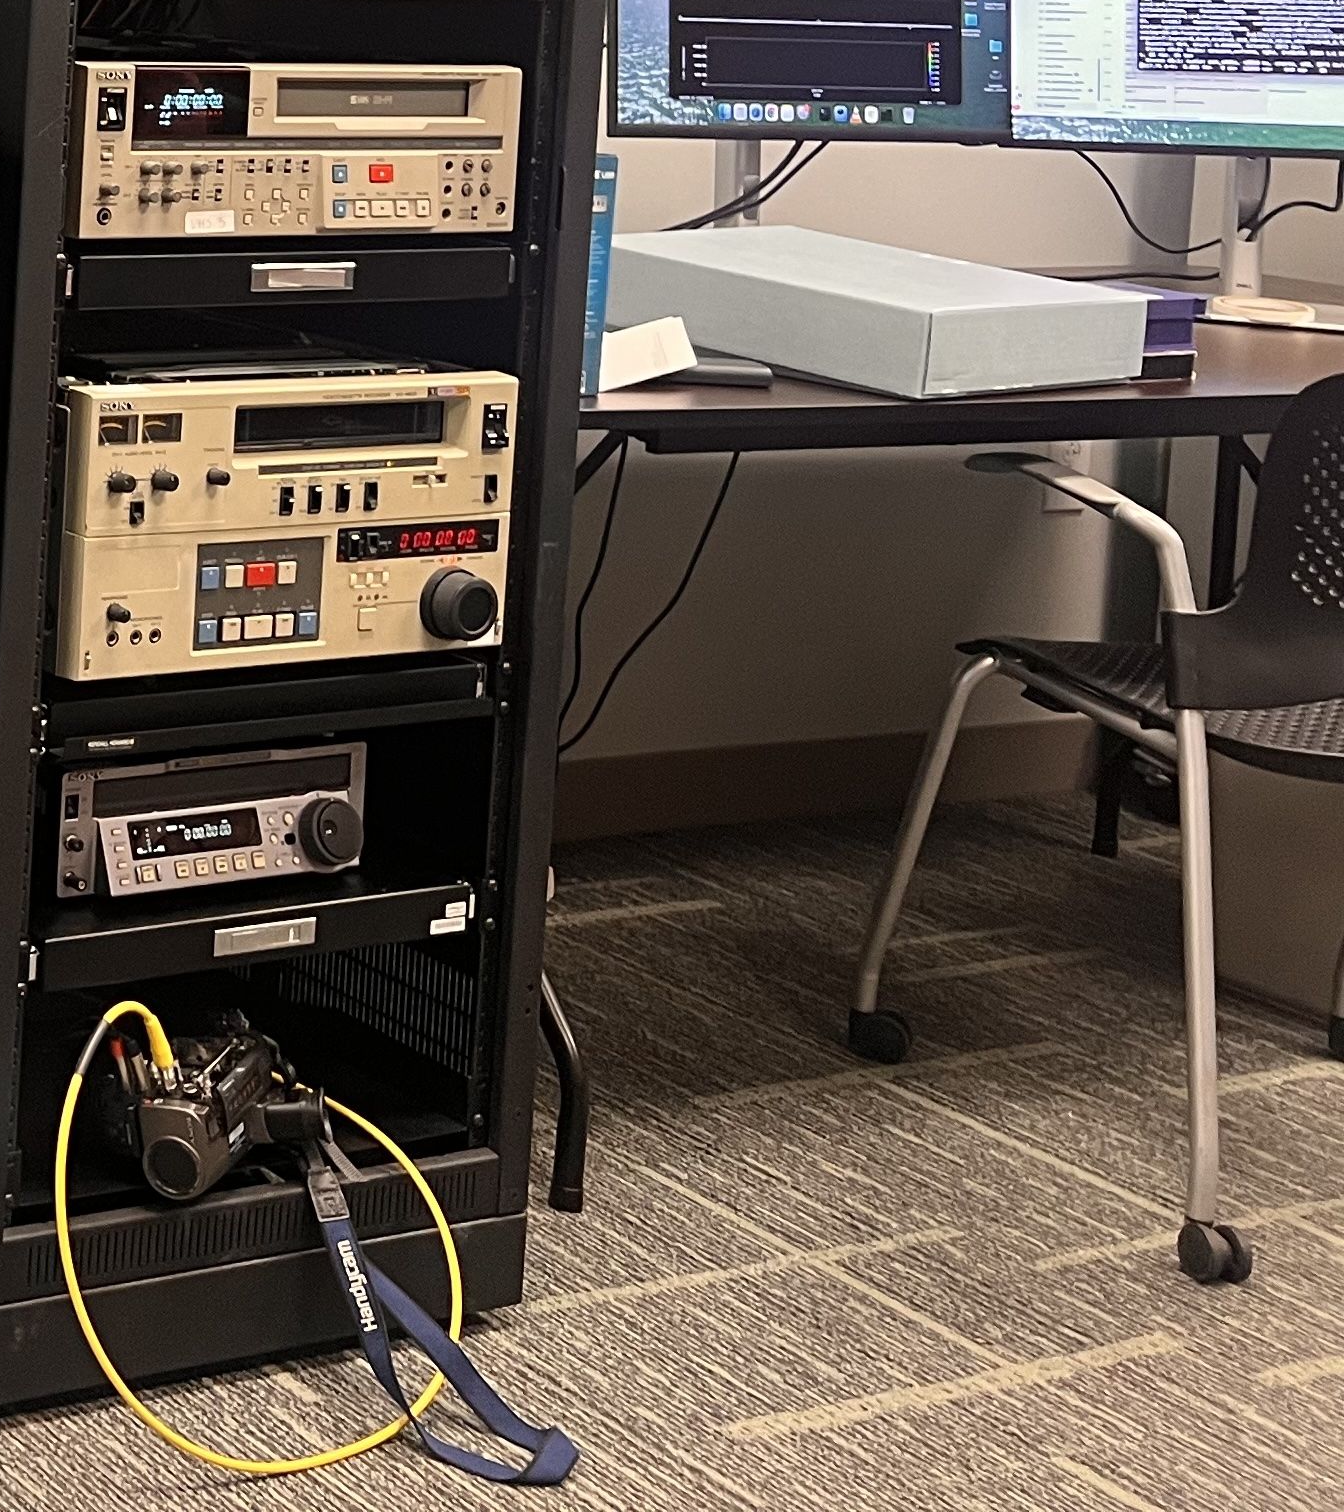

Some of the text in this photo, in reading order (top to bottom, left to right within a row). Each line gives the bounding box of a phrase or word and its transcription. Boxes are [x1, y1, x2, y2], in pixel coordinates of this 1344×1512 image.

[97, 70, 133, 81] SONY
[100, 401, 136, 413] SONY
[68, 770, 104, 782] SONY
[337, 1239, 377, 1333] Handycam
